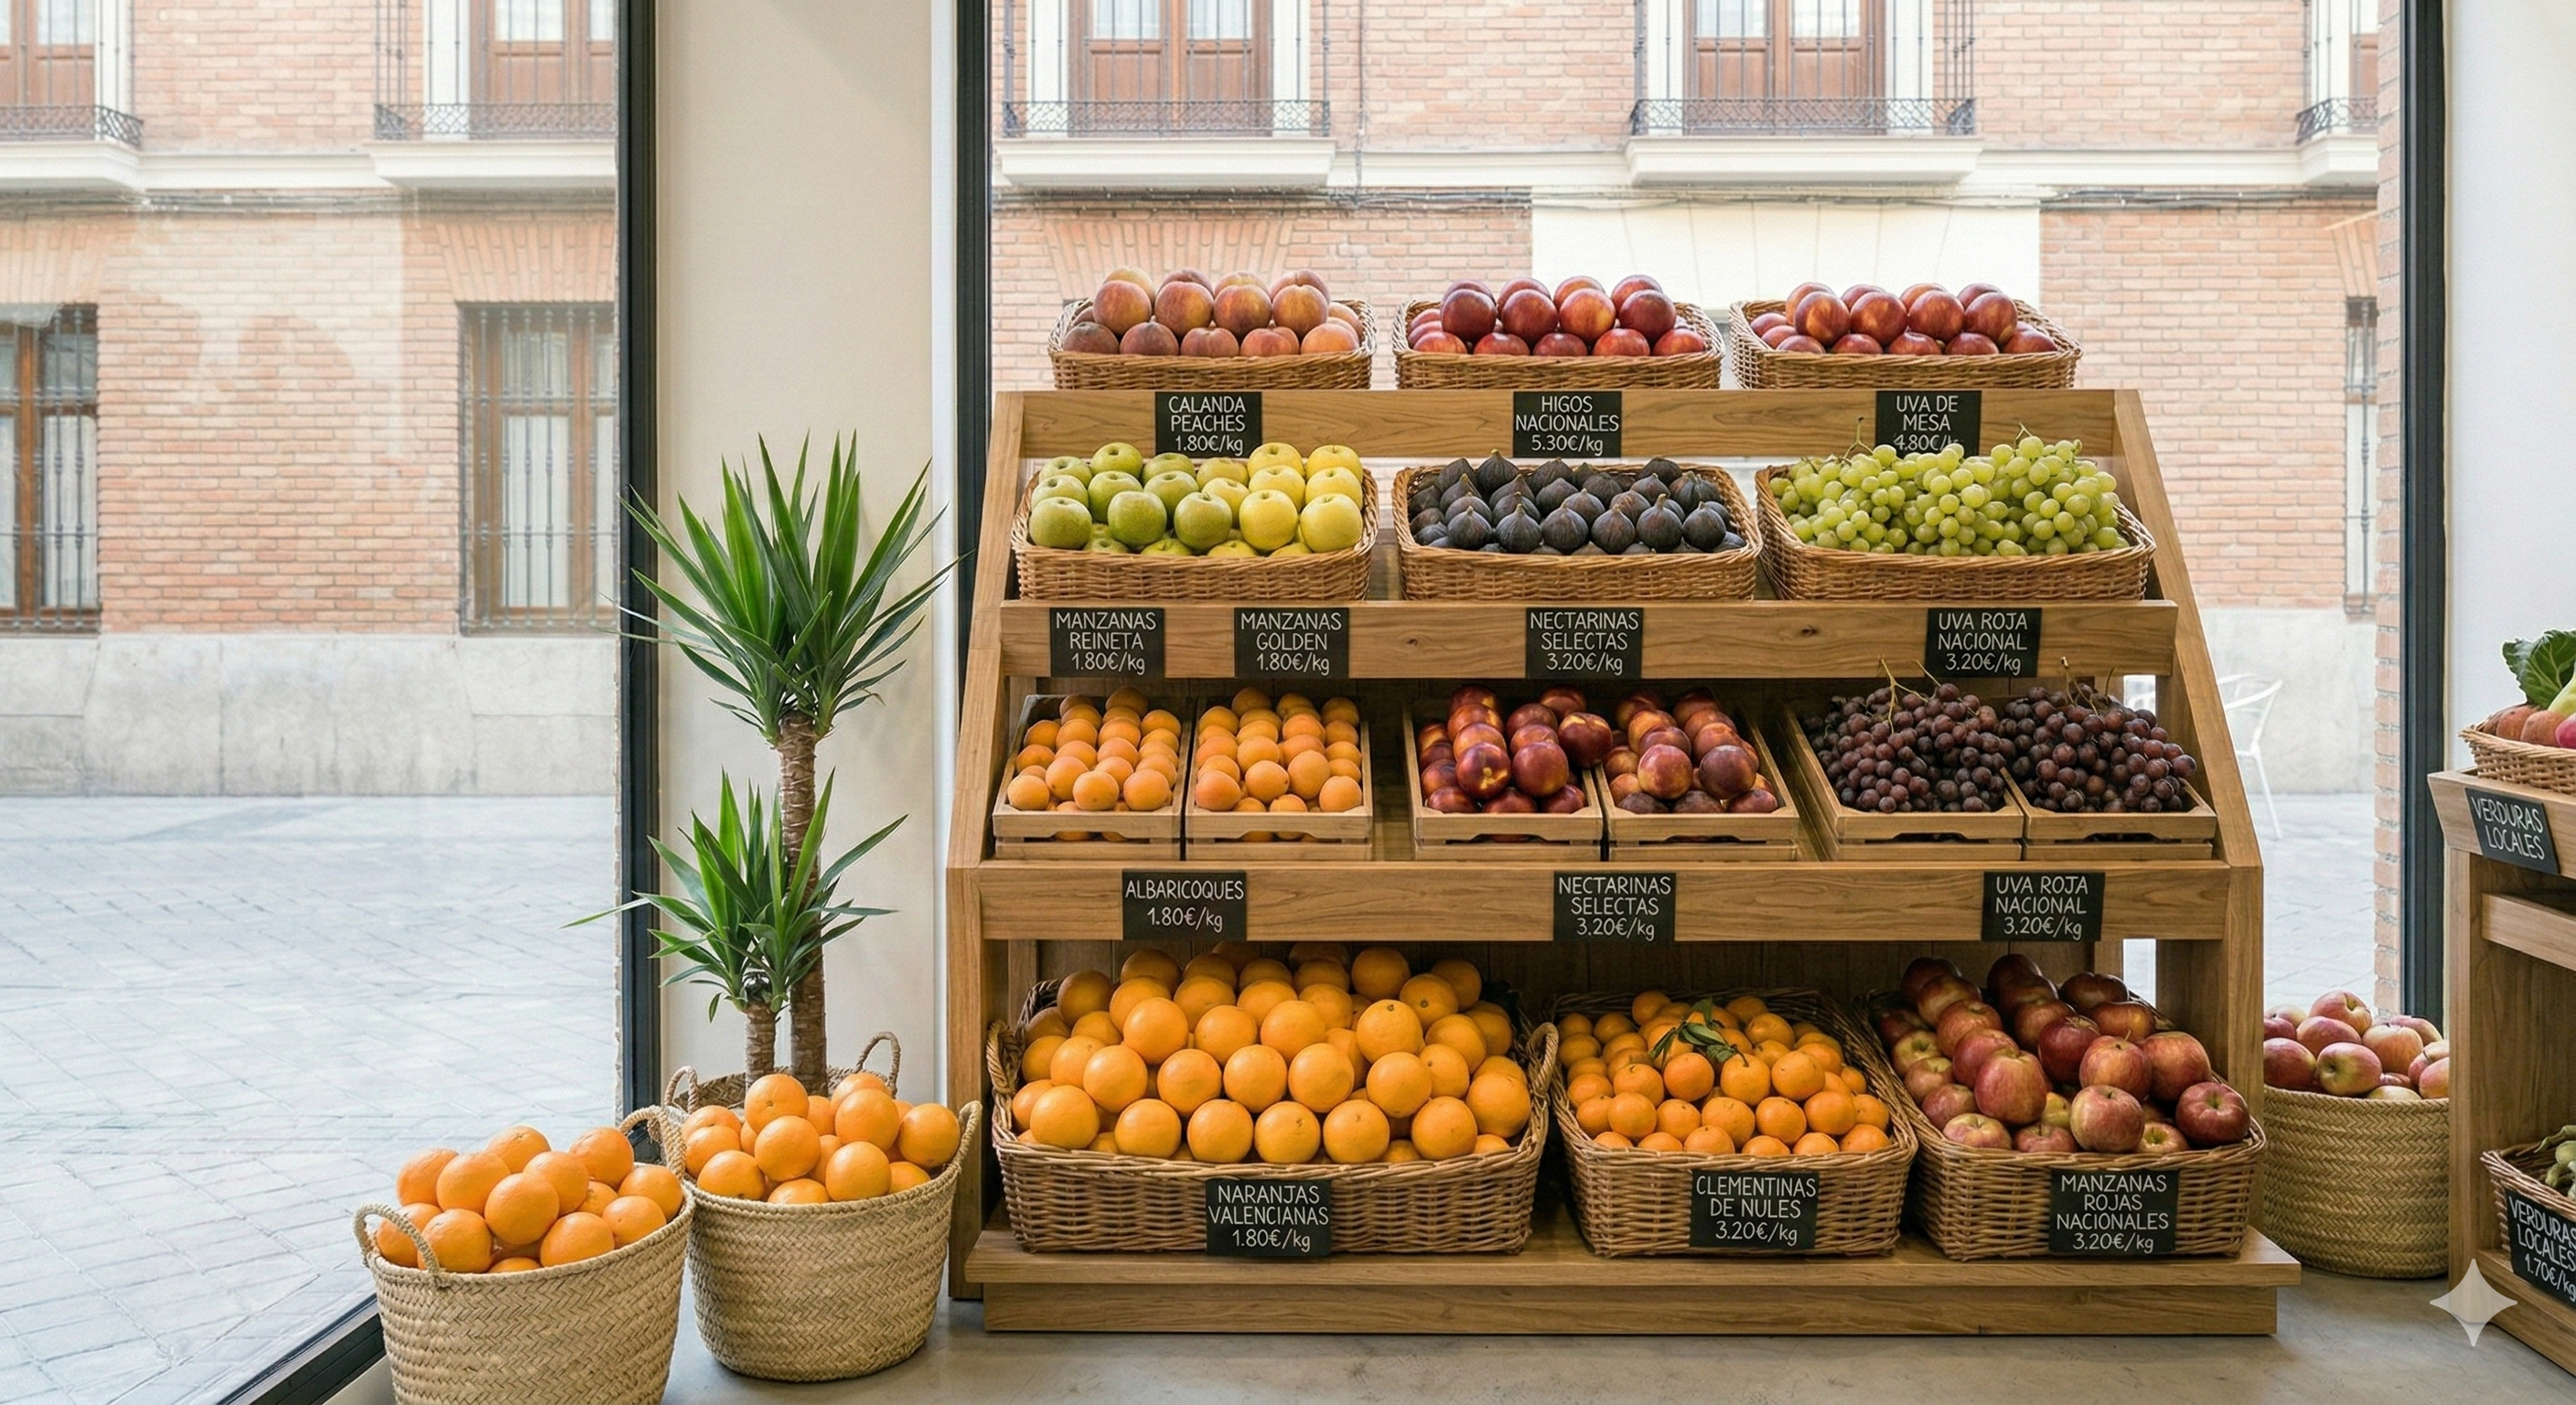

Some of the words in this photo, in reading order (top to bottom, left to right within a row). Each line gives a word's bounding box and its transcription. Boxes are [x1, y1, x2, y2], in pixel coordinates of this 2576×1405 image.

[1169, 396, 1246, 413] CALANDA
[1541, 395, 1593, 413] HIGOS
[1896, 395, 1930, 412] UVA
[1937, 395, 1959, 412] DE
[1171, 414, 1245, 432] PEACHES
[1516, 414, 1619, 432] NACIONALES
[1903, 413, 1951, 431] MESA
[1056, 612, 1156, 630] MANZANAS
[1241, 612, 1342, 631] MANZANAS
[1530, 612, 1639, 630] NECTARINAS
[1938, 612, 1974, 630] UVA
[1981, 612, 2028, 630] ROJA
[1070, 632, 1143, 649] REINETA
[1256, 632, 1327, 650] GOLDEN
[1541, 632, 1628, 650] SELECTAS
[1938, 632, 2028, 650] NACIONAL
[1071, 652, 1145, 675] 1.80€/kg
[1256, 652, 1330, 675] 1.80€/kg
[1946, 652, 2021, 676] 3.20€/kg
[2471, 796, 2544, 833] VERDURAS
[2485, 825, 2545, 860] LOCALES
[1125, 880, 1244, 901] ALBARICOQUES
[1559, 876, 1671, 895] NECTARINAS
[1996, 875, 2034, 894] UVA
[2040, 875, 2088, 895] ROJA
[1571, 896, 1659, 915] SELECTAS
[1995, 896, 2087, 914] NACIONAL
[1147, 906, 1223, 933] 1.80€/kg
[1696, 1175, 1817, 1197] CLEMENTINAS
[2061, 1174, 2167, 1193] MANZANAS
[1218, 1185, 1320, 1204] NARANJAS
[2084, 1194, 2142, 1211] ROJAS
[1208, 1206, 1329, 1225] VALENCIANAS
[1710, 1197, 1734, 1217] DE
[1741, 1198, 1801, 1218] NULES
[2056, 1212, 2170, 1230] NACIONALES
[1232, 1228, 1311, 1253] 1.80€/kg
[1715, 1220, 1798, 1247] 3.20€/kg
[2072, 1232, 2154, 1254] 3.20€/kg
[2517, 1223, 2576, 1272] LOCALES
